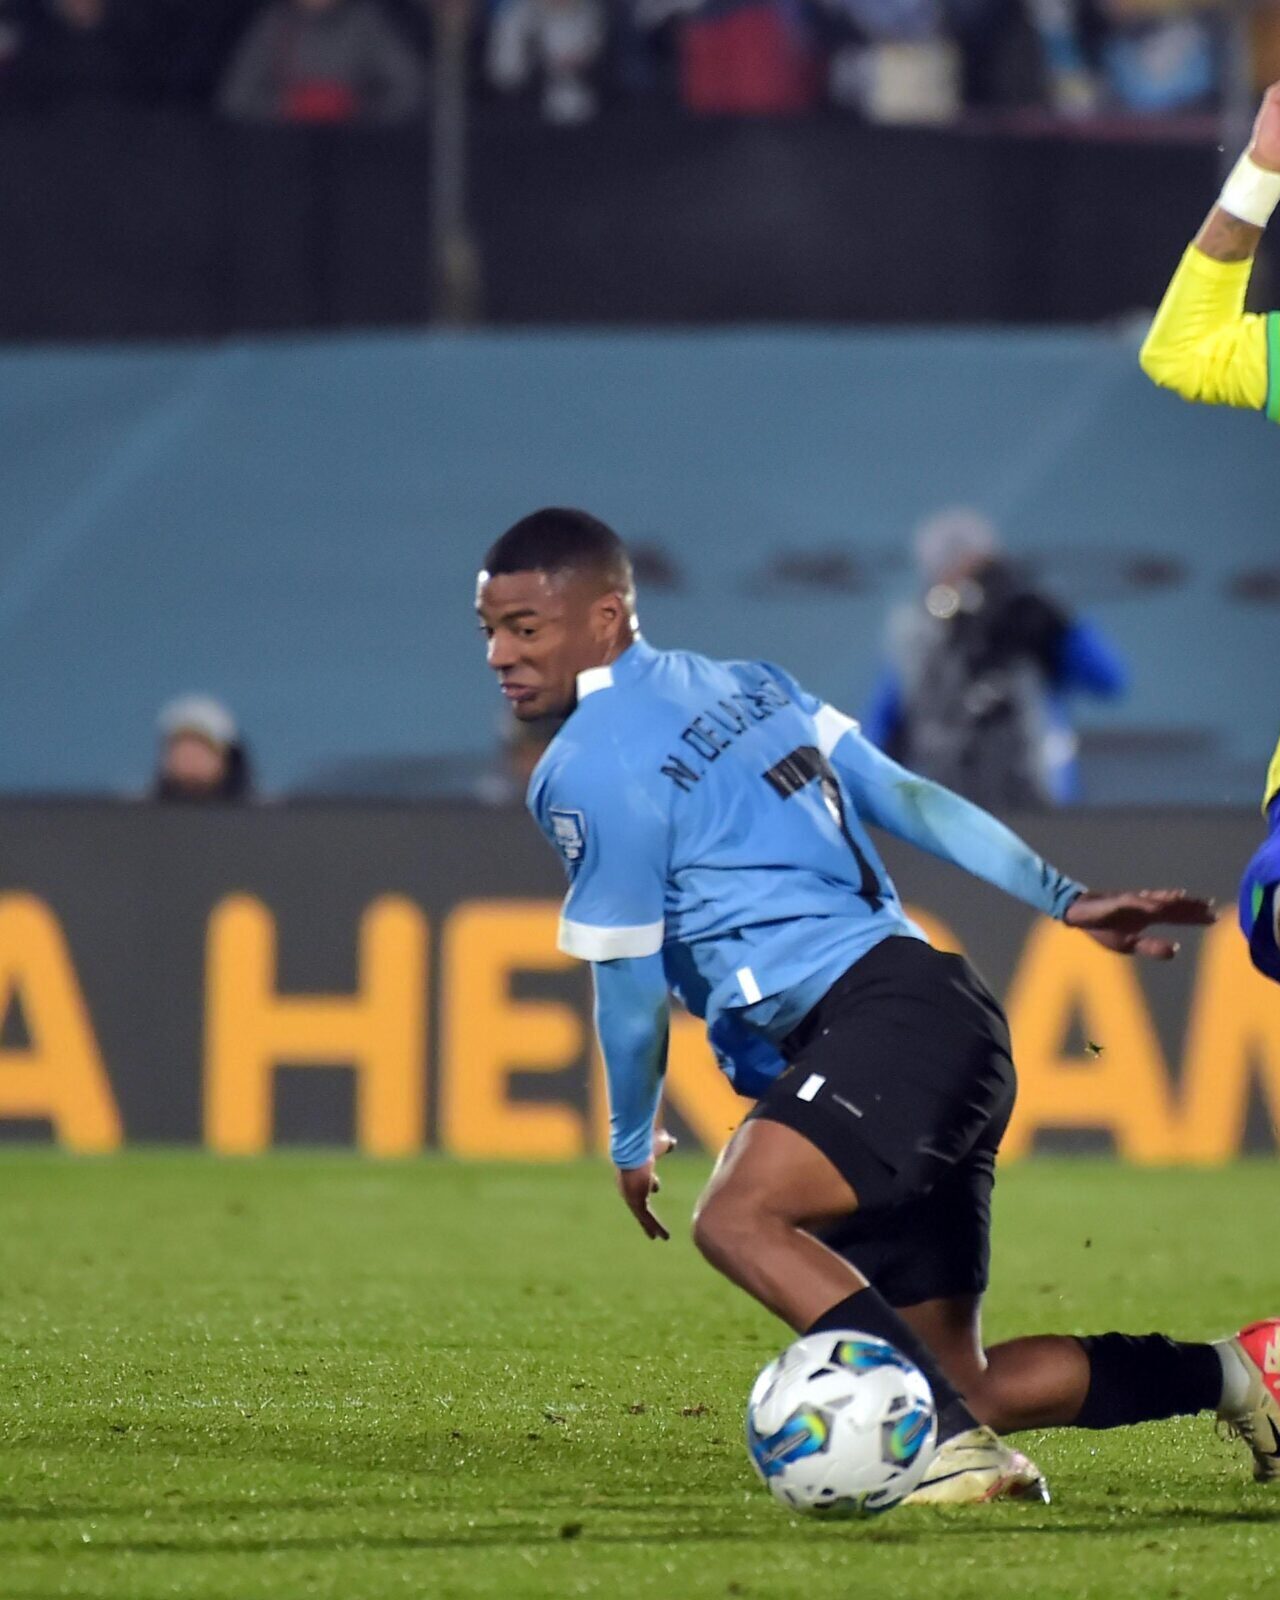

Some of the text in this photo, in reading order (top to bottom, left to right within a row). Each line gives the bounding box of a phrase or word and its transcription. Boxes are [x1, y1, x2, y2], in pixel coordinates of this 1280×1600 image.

[680, 716, 732, 762] DE
[659, 754, 707, 792] N.
[762, 745, 884, 914] 7
